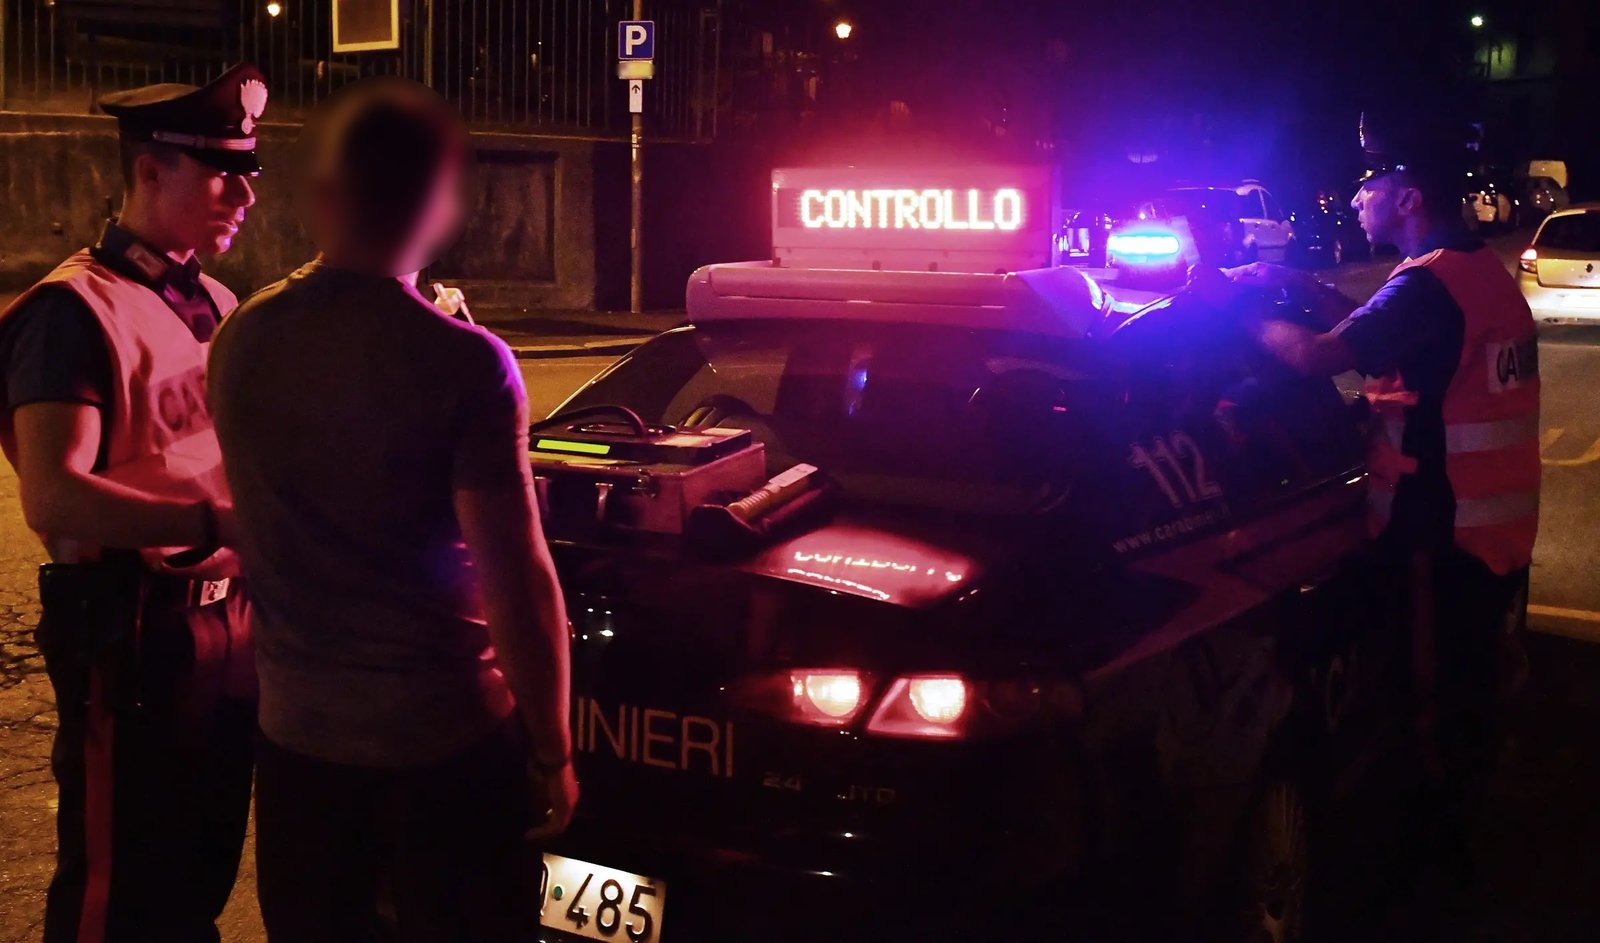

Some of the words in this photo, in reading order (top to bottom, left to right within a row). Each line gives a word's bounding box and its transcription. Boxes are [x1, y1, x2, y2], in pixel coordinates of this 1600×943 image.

[625, 25, 648, 55] P
[800, 188, 1022, 230] CONTROLLO
[1496, 346, 1529, 386] CA
[1127, 430, 1223, 508] 112
